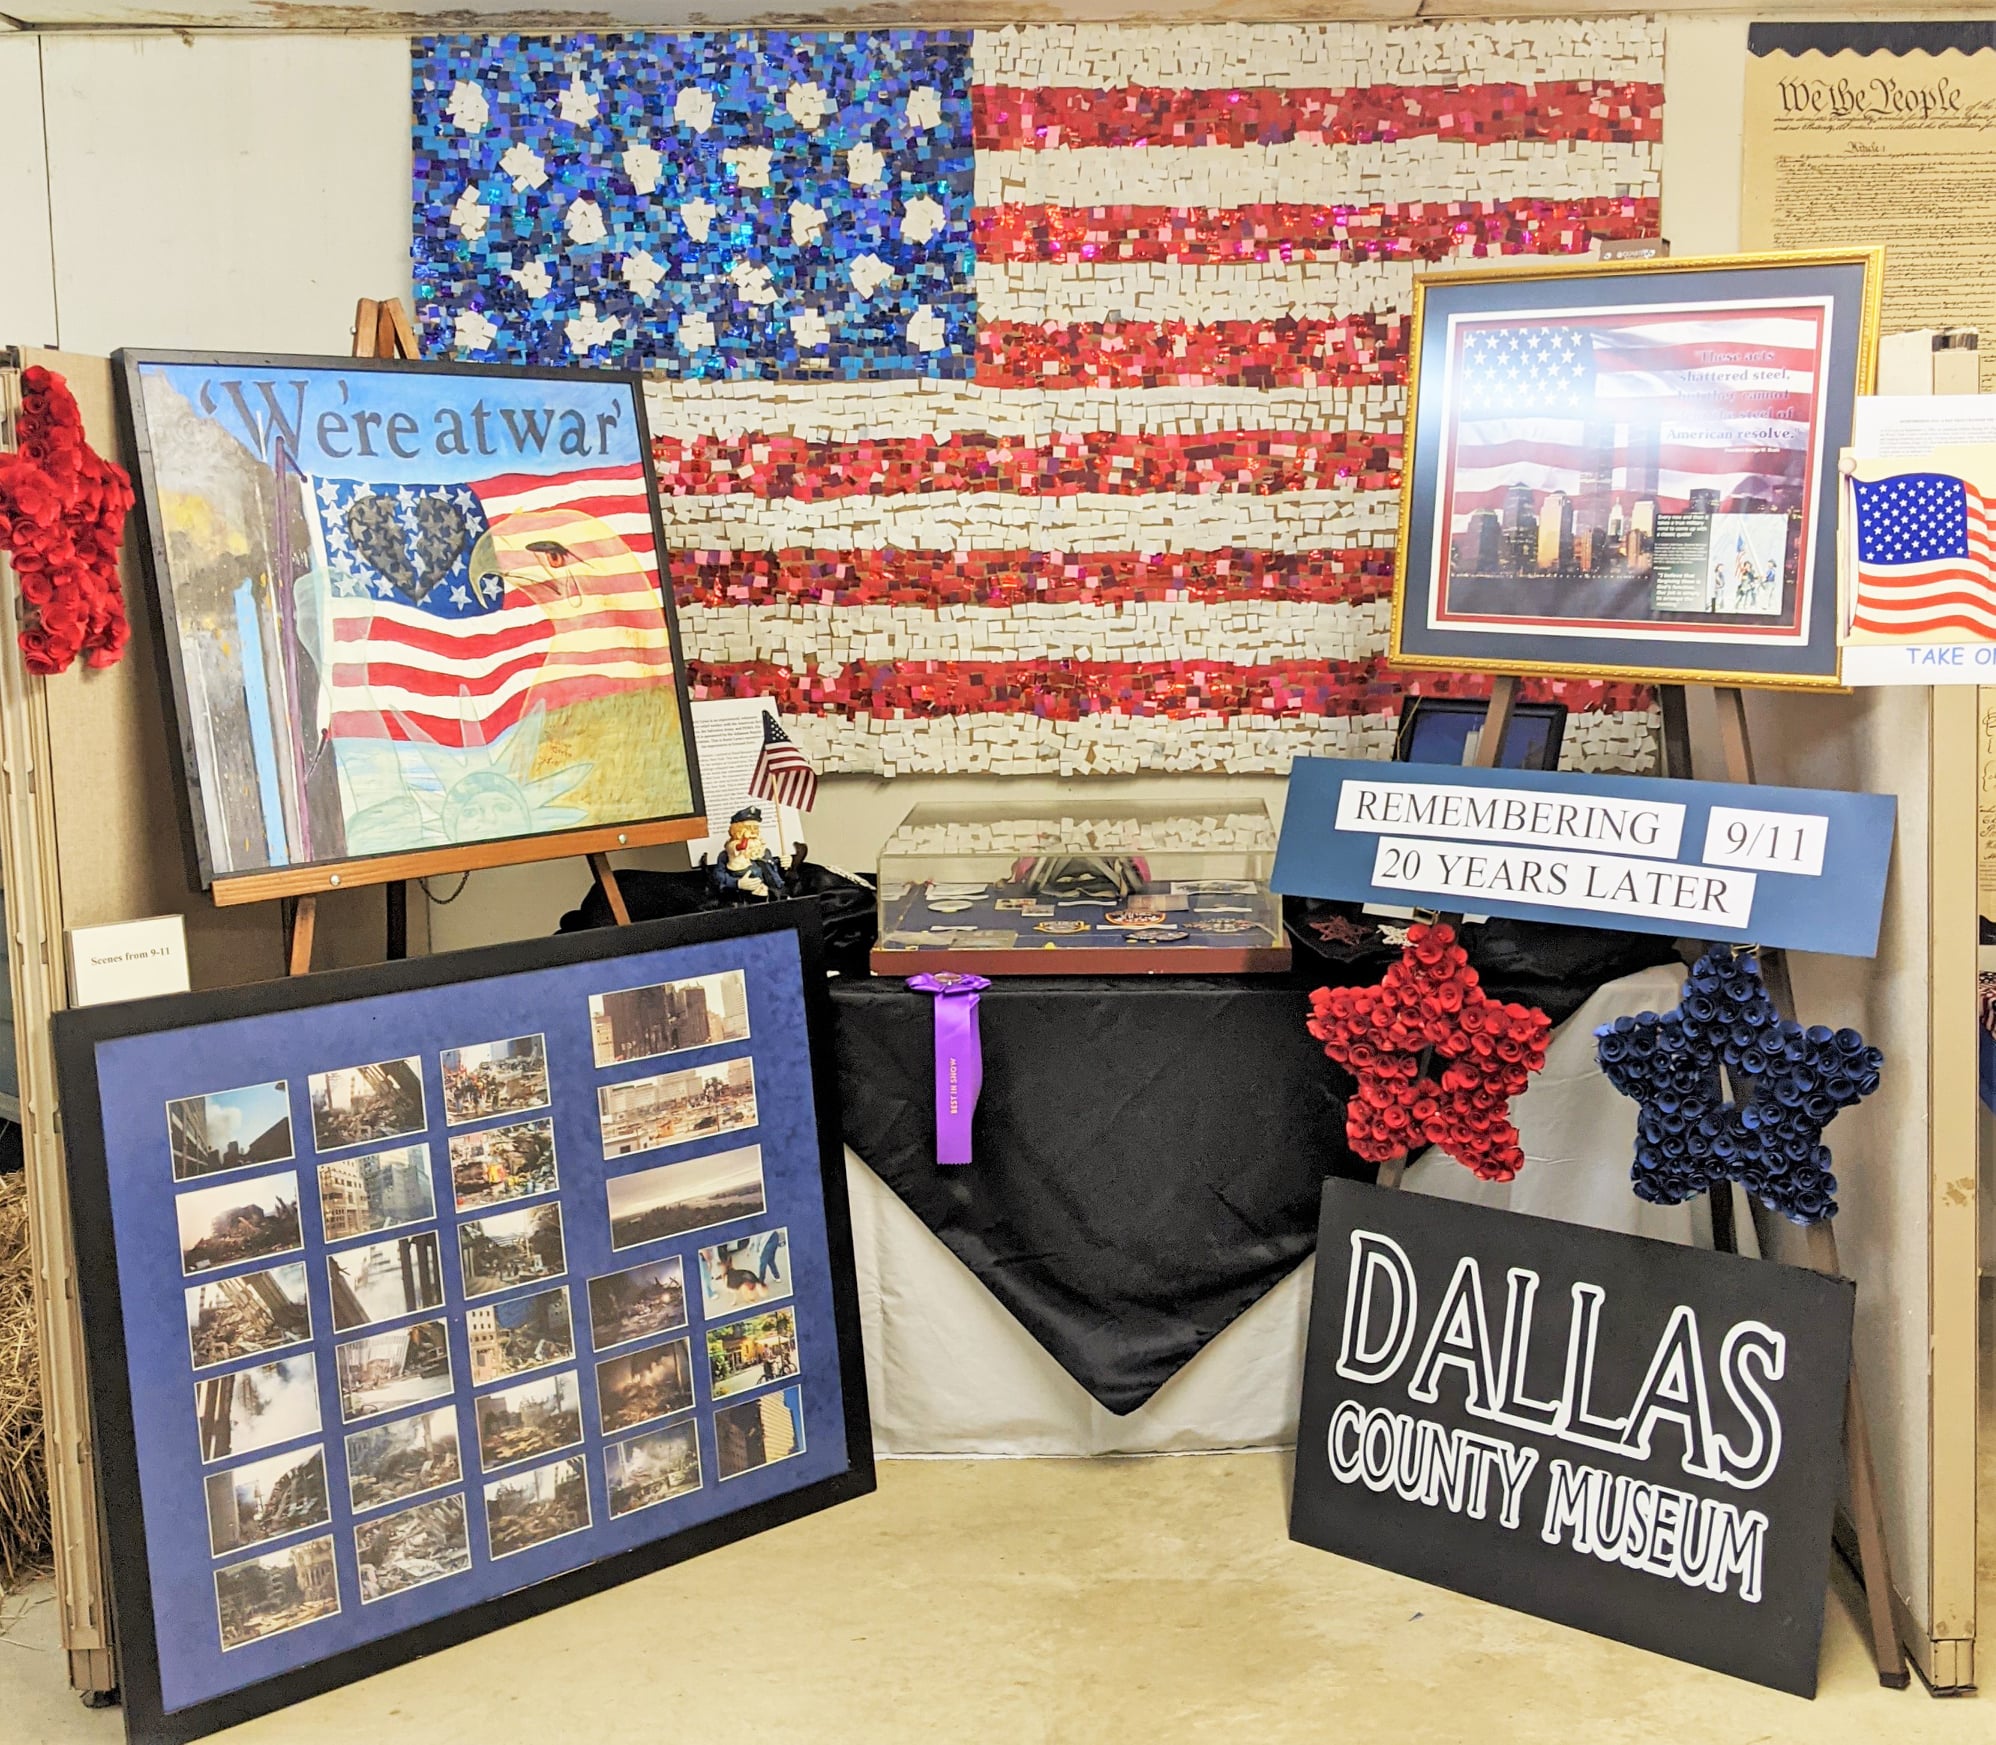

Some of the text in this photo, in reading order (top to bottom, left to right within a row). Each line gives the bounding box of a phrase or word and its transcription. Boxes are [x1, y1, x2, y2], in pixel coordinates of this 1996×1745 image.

[1776, 75, 1829, 116] We
[1829, 78, 1872, 116] the
[1863, 76, 1964, 119] People
[1680, 367, 1790, 382] shattered steel,
[434, 398, 497, 457] at
[1667, 428, 1733, 440] American
[1906, 646, 1965, 666] TAKE
[1355, 789, 1807, 862] REMEMBERING 9/11
[1380, 848, 1731, 914] 20 YEARS LATER
[90, 946, 171, 966] Scenes from 9-11
[1336, 1229, 1785, 1489] DALLAS
[1328, 1400, 1769, 1603] COUNTY MUSEUM
